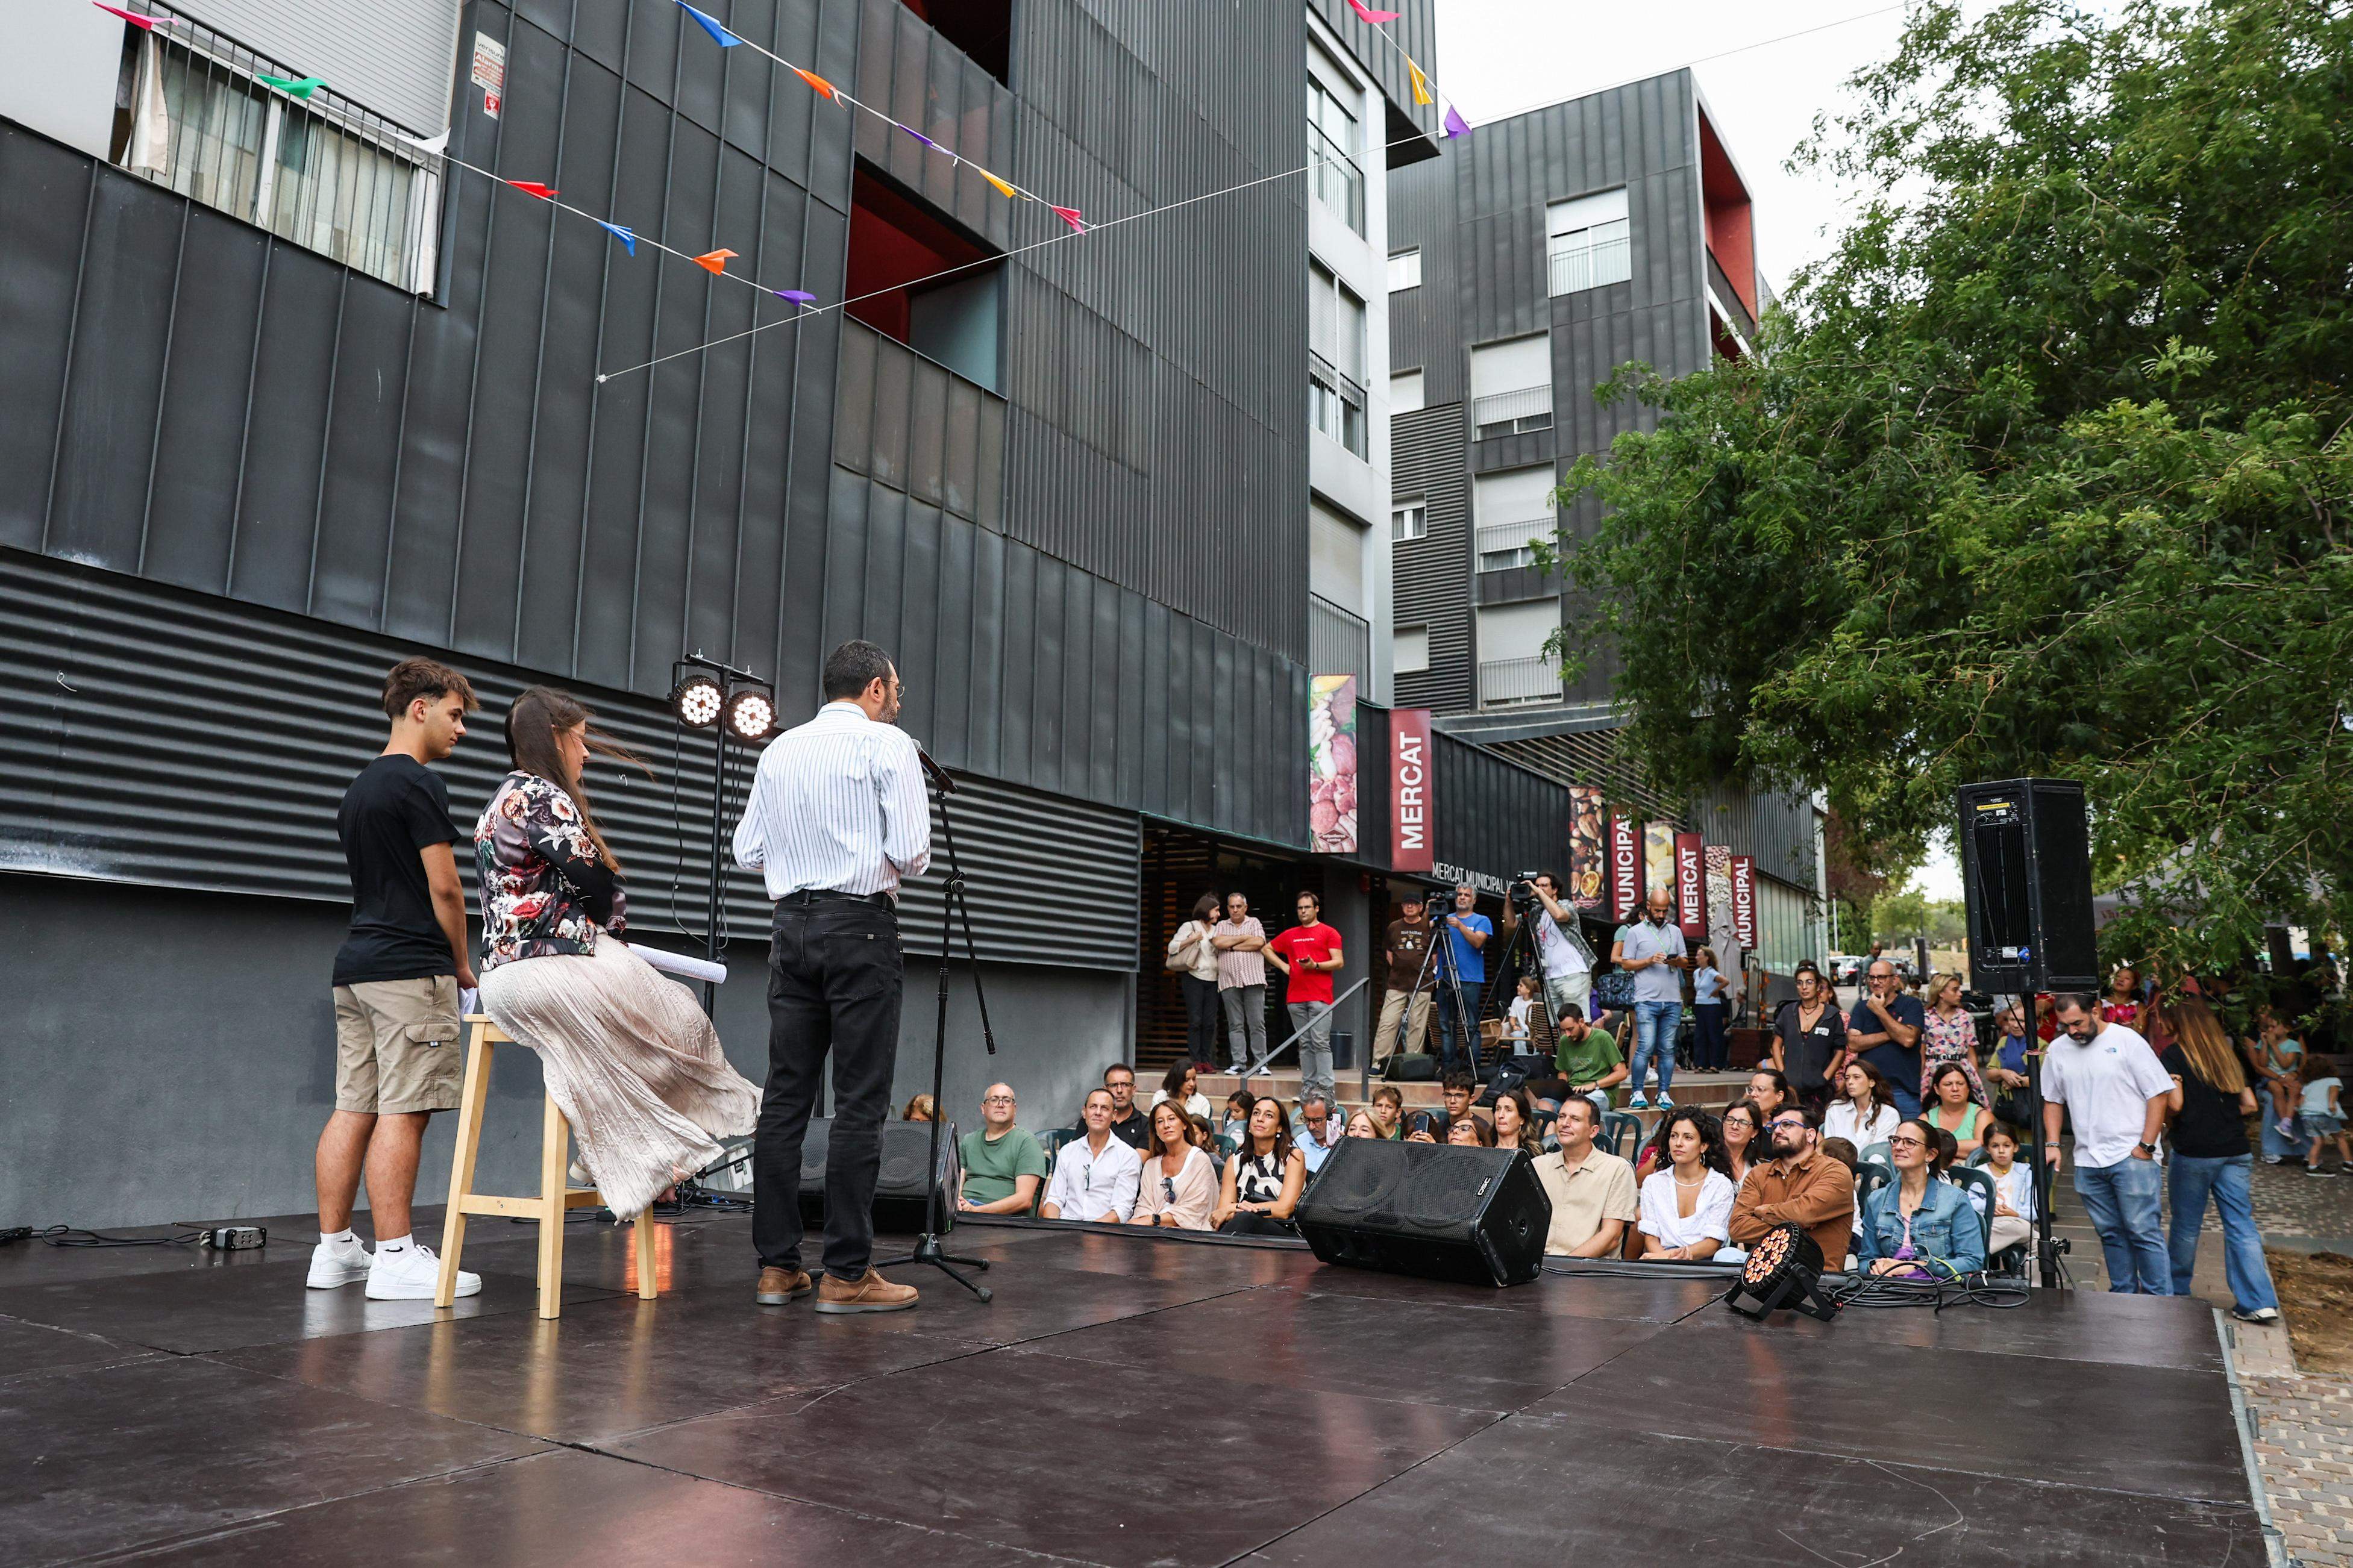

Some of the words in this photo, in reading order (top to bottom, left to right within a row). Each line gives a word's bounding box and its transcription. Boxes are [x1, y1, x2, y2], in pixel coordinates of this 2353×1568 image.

[1399, 731, 1423, 849] MERCAT
[1432, 861, 1464, 883] MERCAT
[1465, 869, 1505, 894] MUNICIPAL
[1682, 847, 1699, 924] MERCAT
[1735, 857, 1752, 947] MUNICIPAL
[1477, 1177, 1491, 1196] QSC
